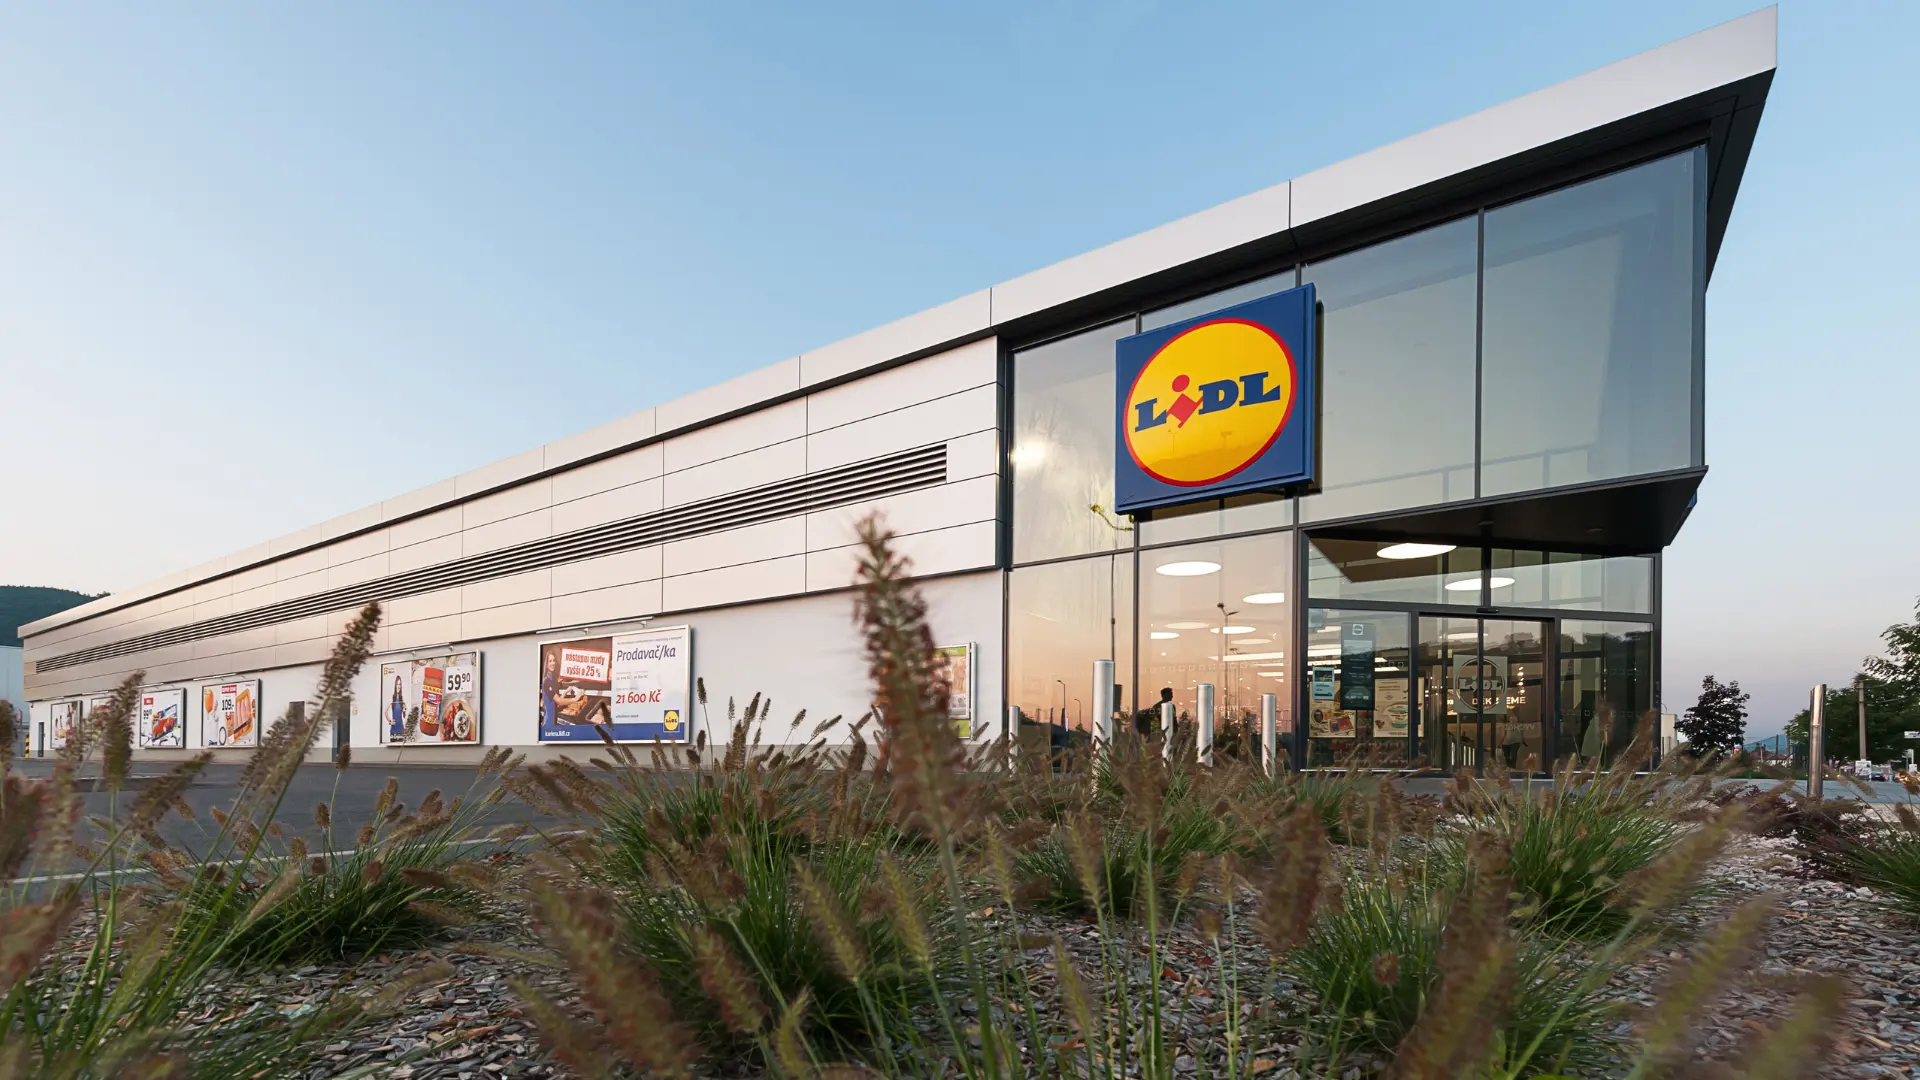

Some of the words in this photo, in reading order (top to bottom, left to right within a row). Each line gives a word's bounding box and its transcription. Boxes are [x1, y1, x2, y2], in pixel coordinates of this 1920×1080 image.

[617, 645, 676, 662] Prodavač/ka
[586, 665, 595, 677] 25
[616, 694, 625, 704] 21
[628, 691, 647, 704] 600
[649, 689, 662, 703] Kč
